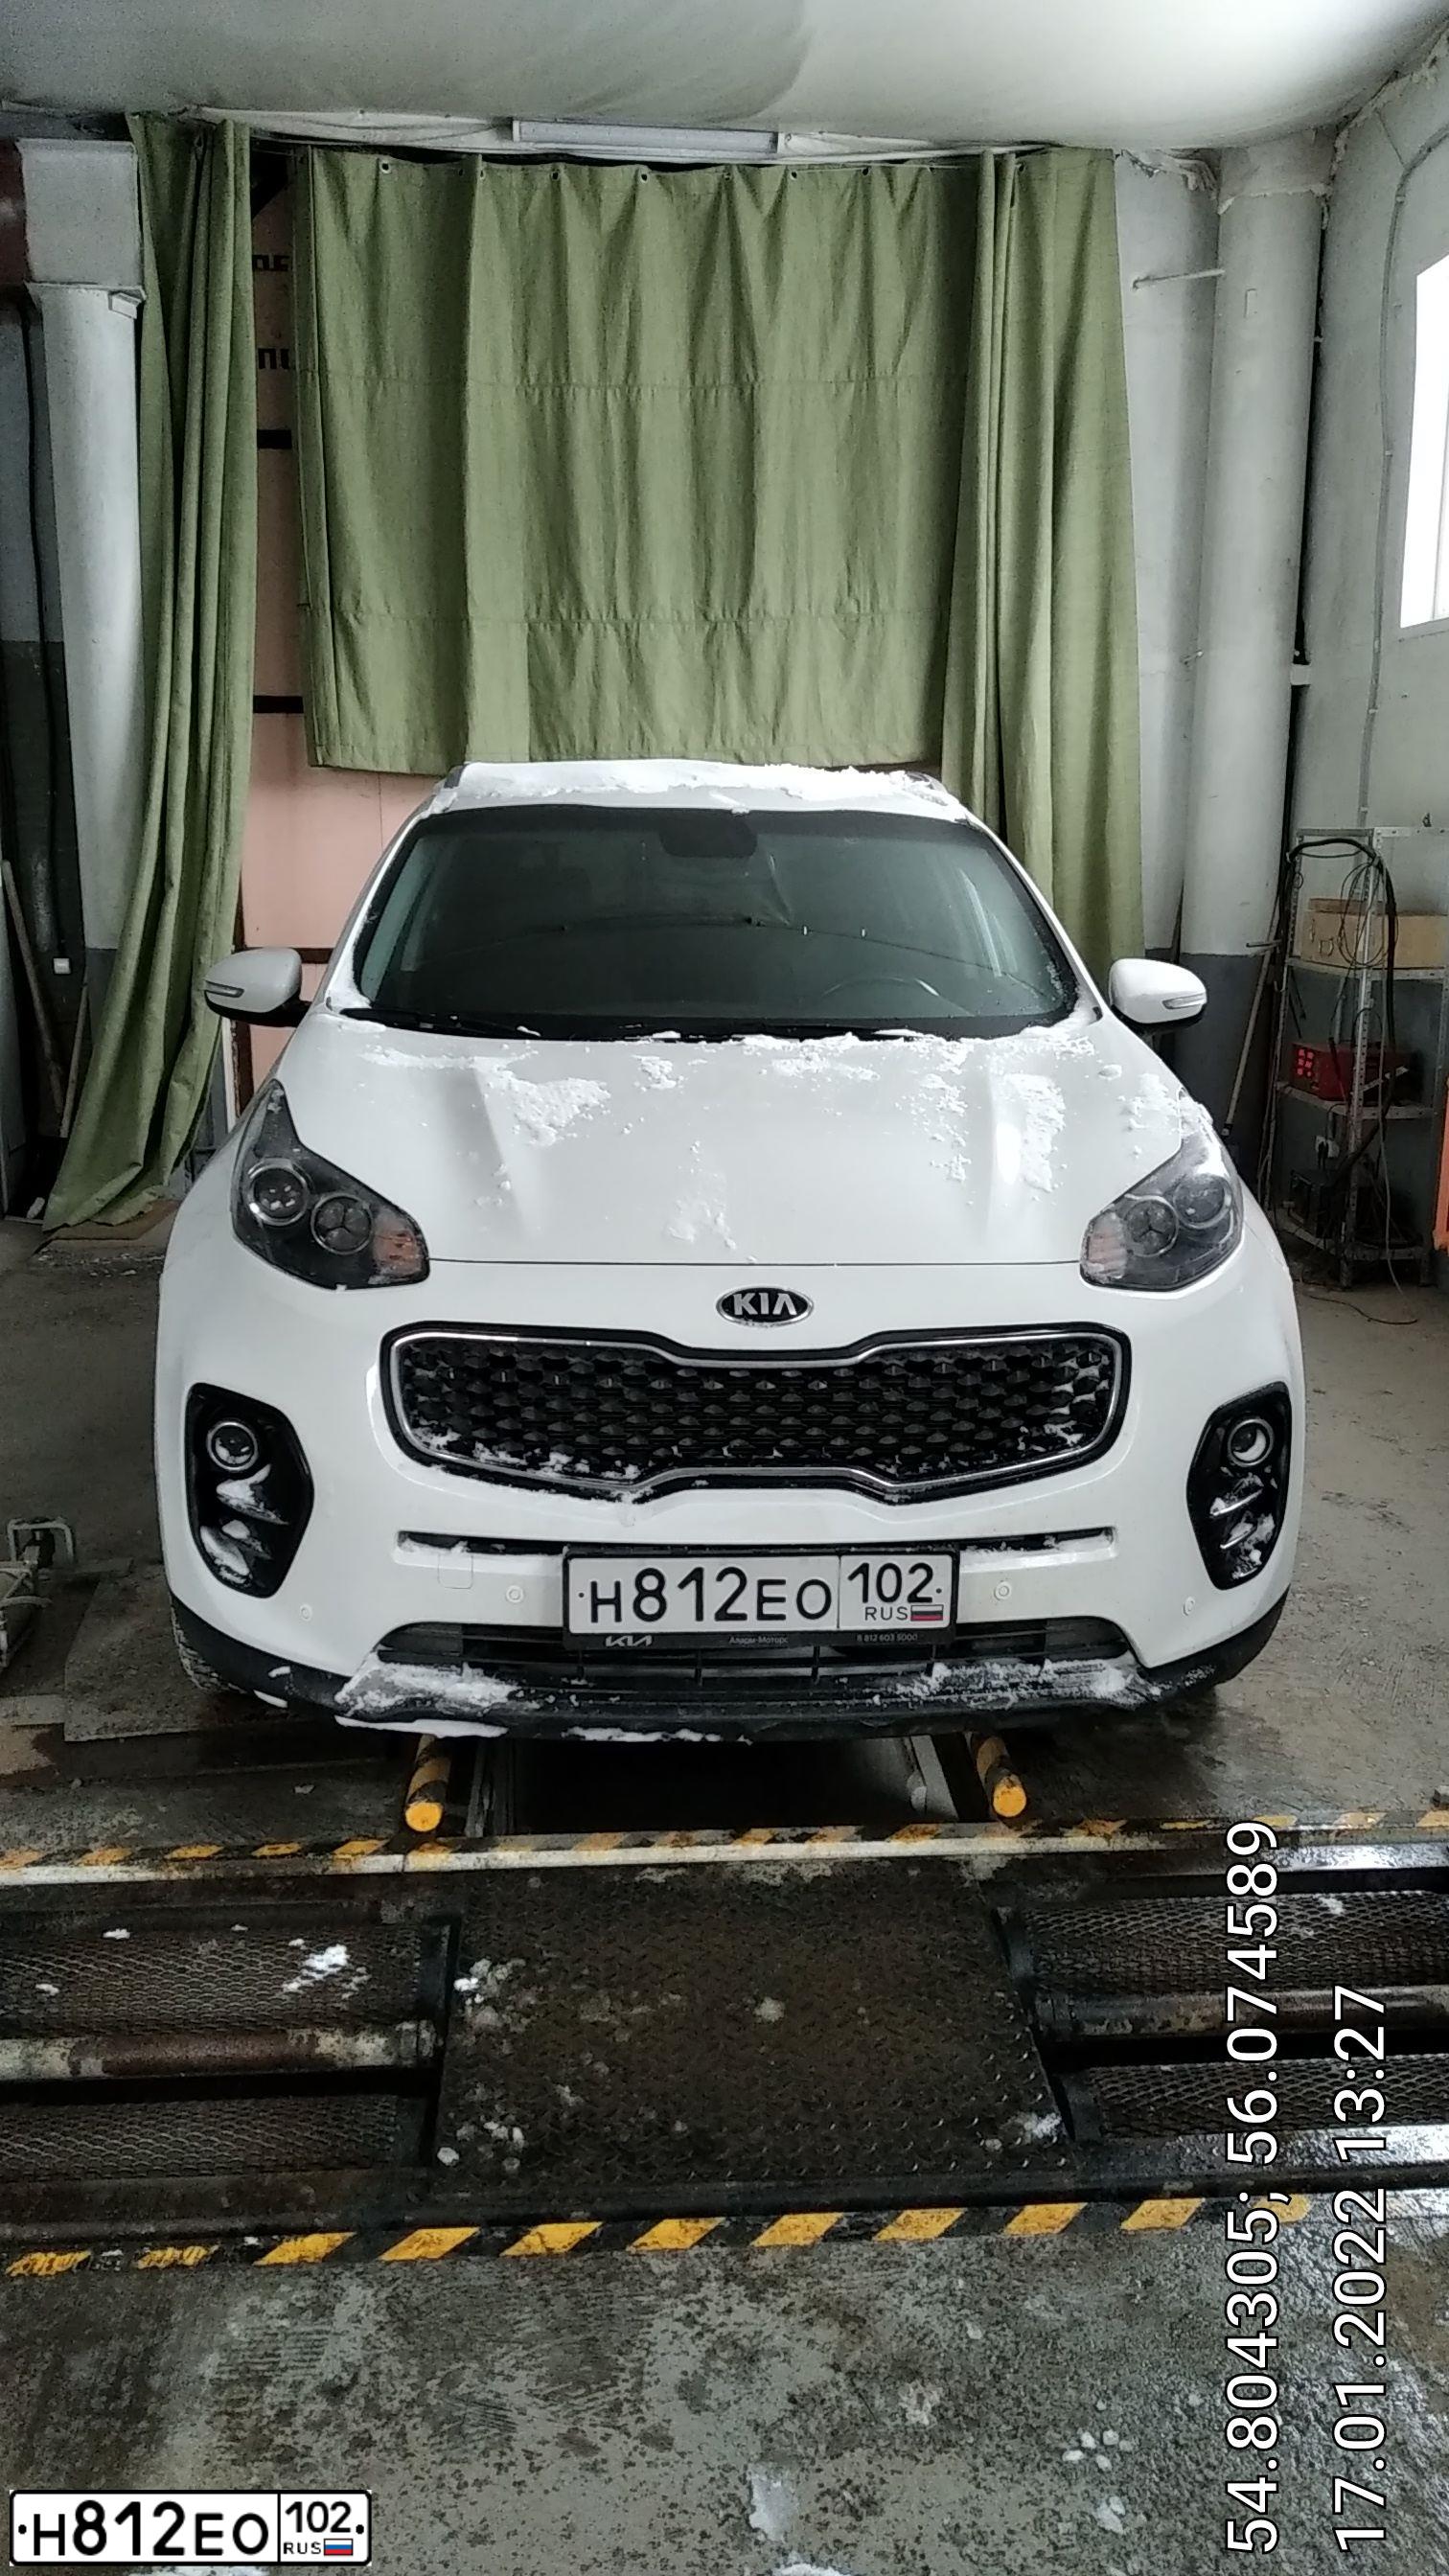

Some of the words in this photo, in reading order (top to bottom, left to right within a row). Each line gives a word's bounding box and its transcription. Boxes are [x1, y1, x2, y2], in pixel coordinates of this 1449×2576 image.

[732, 1292, 797, 1316] KIA
[847, 1562, 933, 1604] 102
[864, 1606, 908, 1622] RUS
